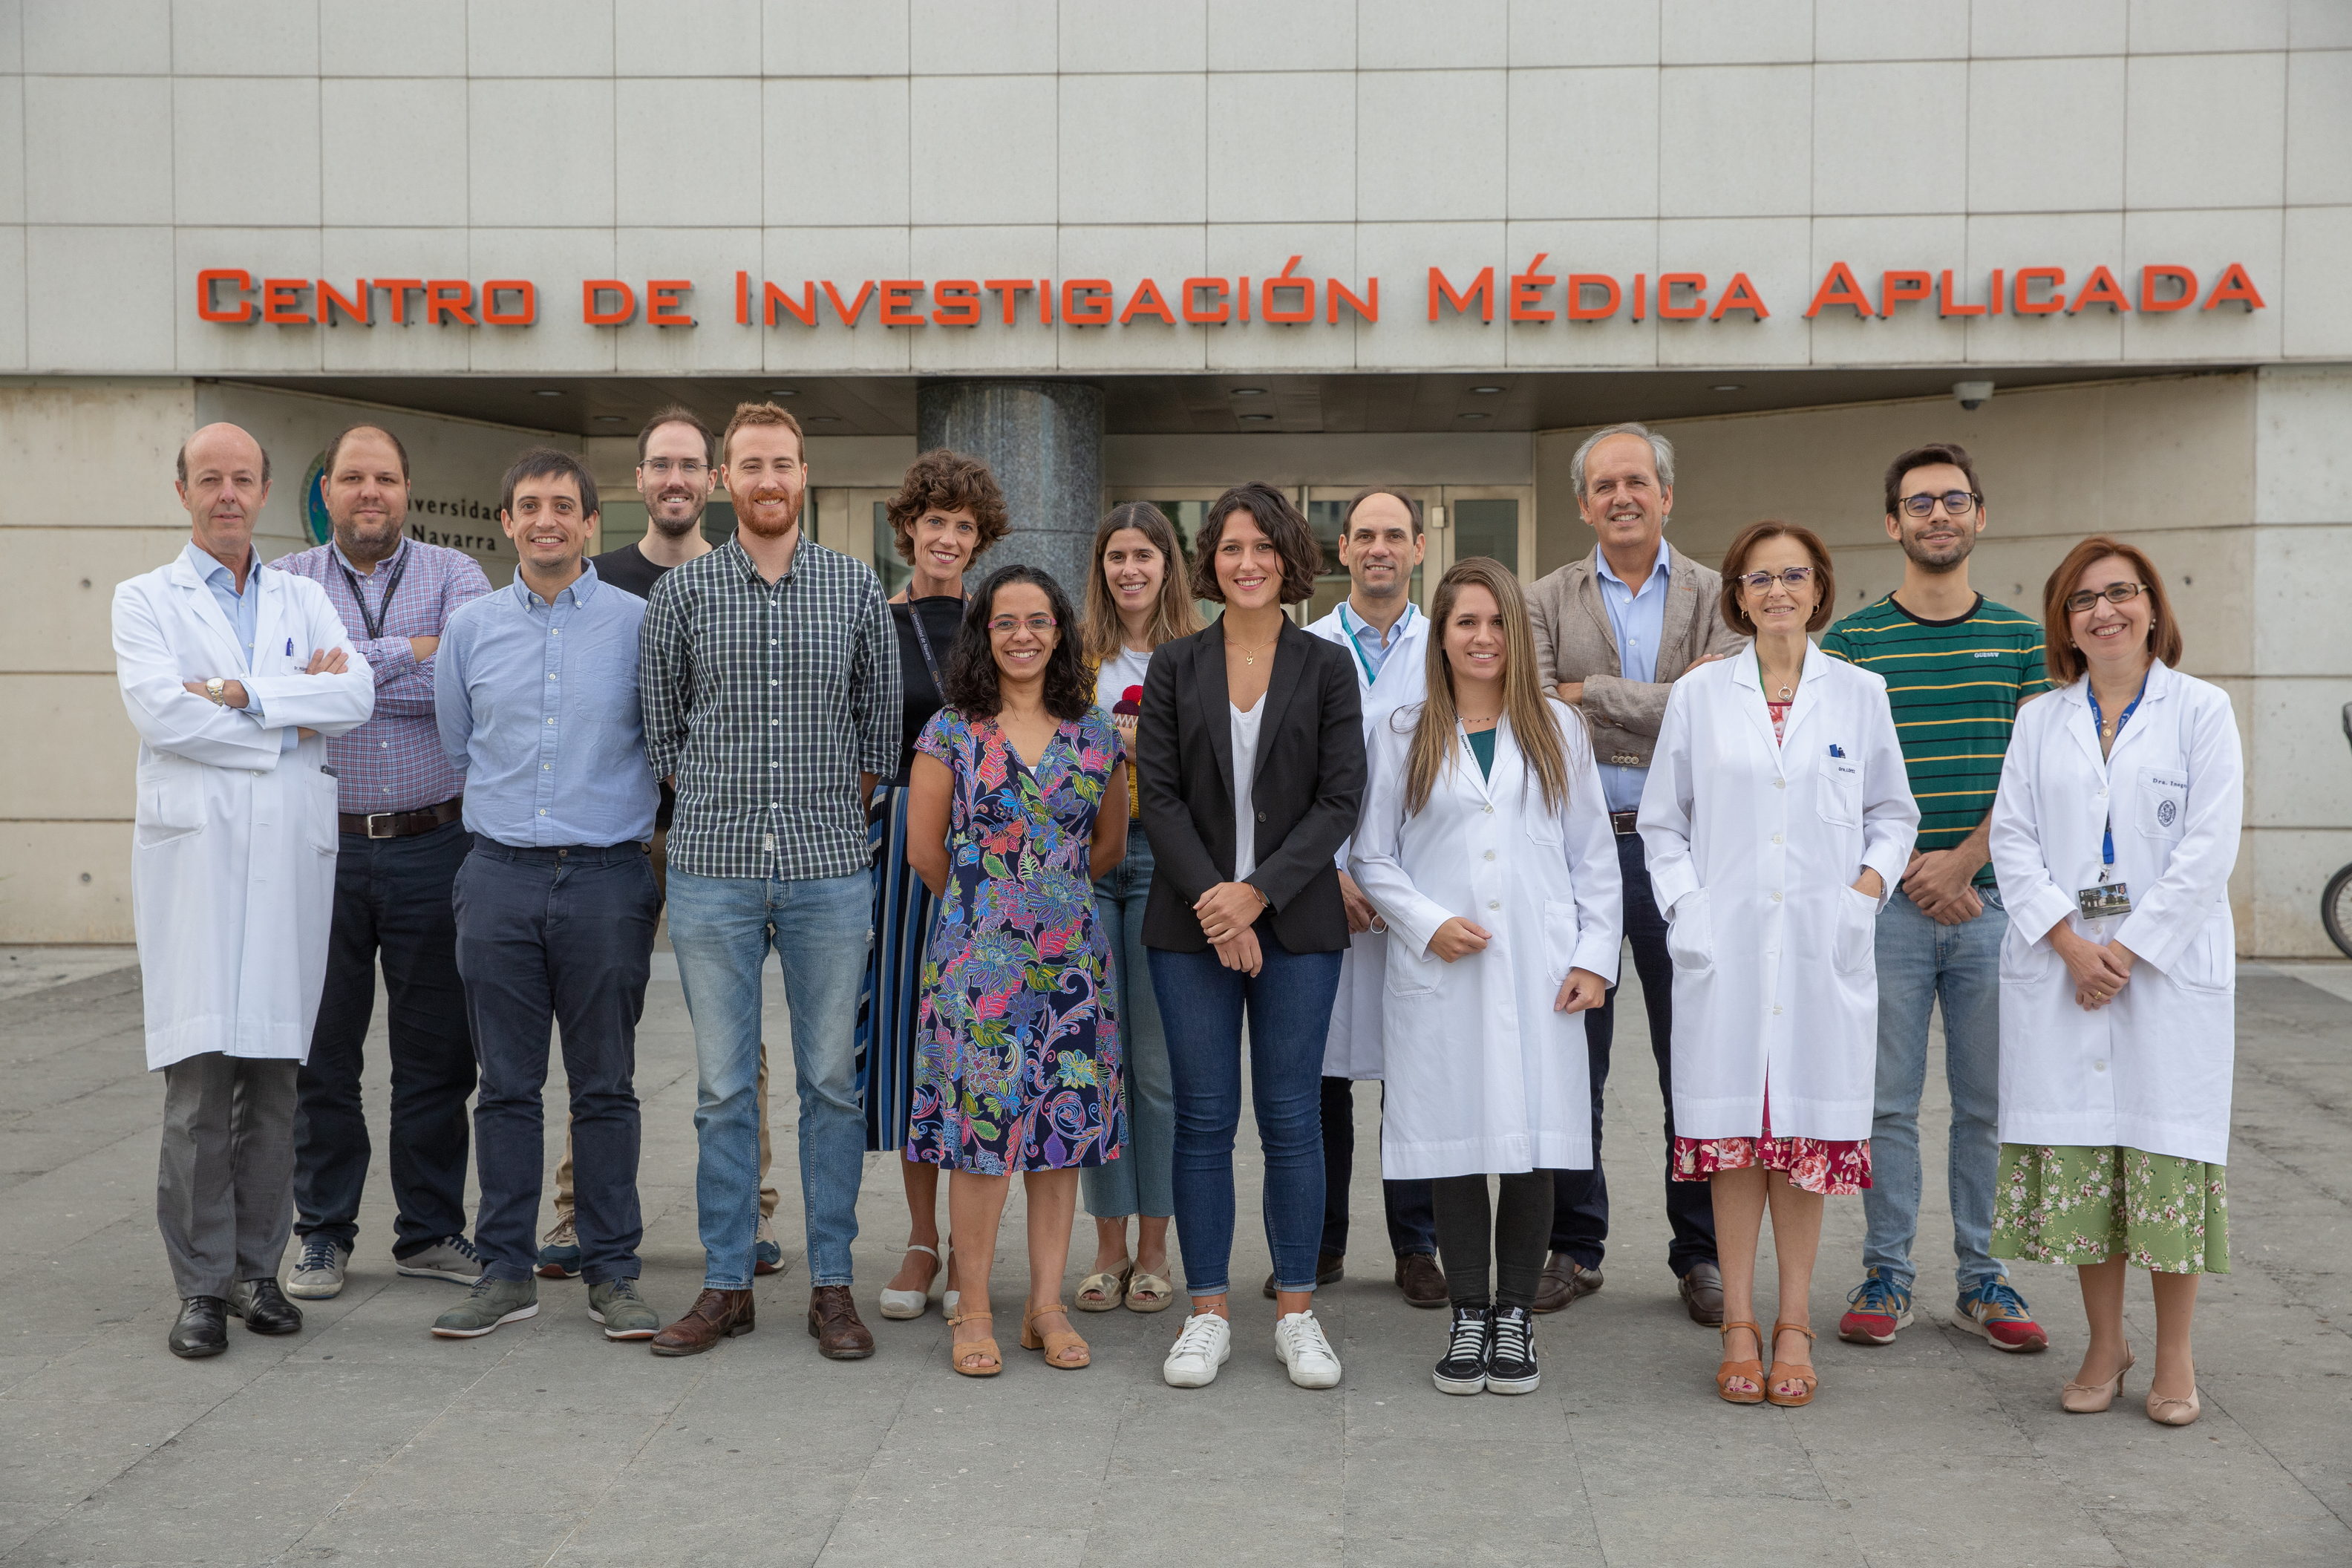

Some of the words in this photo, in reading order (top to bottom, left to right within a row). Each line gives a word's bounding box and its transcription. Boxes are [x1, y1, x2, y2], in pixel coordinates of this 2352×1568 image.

[197, 269, 535, 325] CENTRO
[583, 279, 692, 325] DE
[736, 255, 1379, 327] INVESTIGACIÓN
[1428, 253, 1770, 321] MÉDICA
[1805, 261, 2266, 318] APLICADA
[411, 524, 496, 551] Navarra
[912, 612, 924, 638] Universidad
[922, 643, 932, 661] Navarra
[2152, 777, 2168, 785] Dra.
